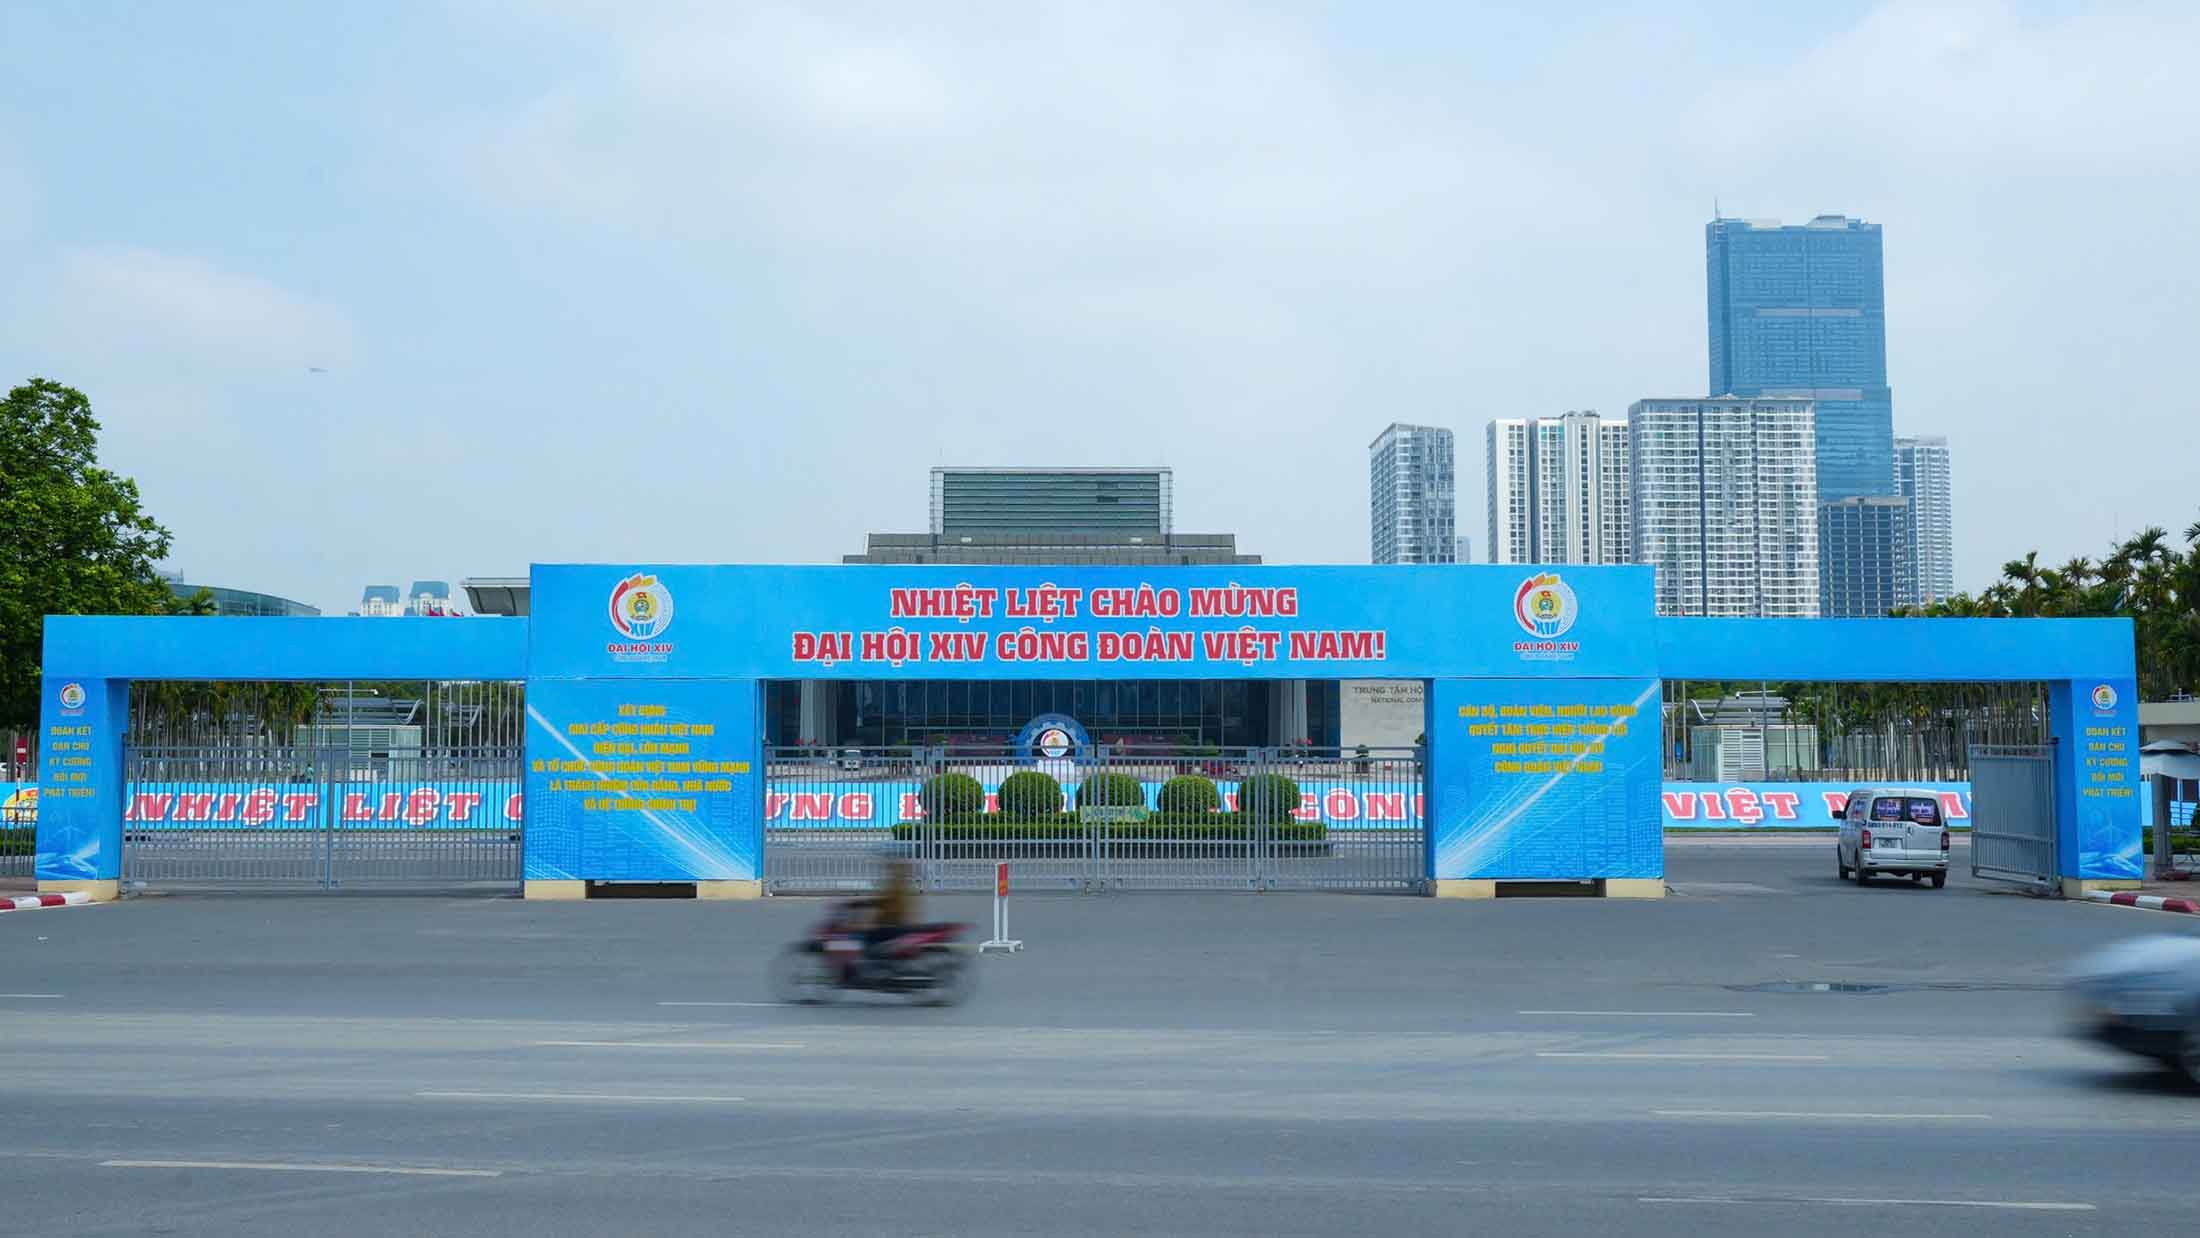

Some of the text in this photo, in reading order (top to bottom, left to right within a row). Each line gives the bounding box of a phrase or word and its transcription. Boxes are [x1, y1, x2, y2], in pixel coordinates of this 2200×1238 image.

[890, 582, 1297, 622] NHIỆT LIỆT CHÀO MỪNG
[631, 642, 651, 653] HỘI
[654, 643, 673, 652] XIV
[793, 626, 1386, 666] ĐẠI HỘI XIV CÔNG ĐOÀN VIỆT NAM!
[1560, 642, 1578, 651] XIV
[1352, 686, 1386, 694] TRUNG
[1410, 684, 1424, 695] HỘ
[343, 787, 482, 825] LIỆT
[1662, 786, 1800, 825] VIỆT
